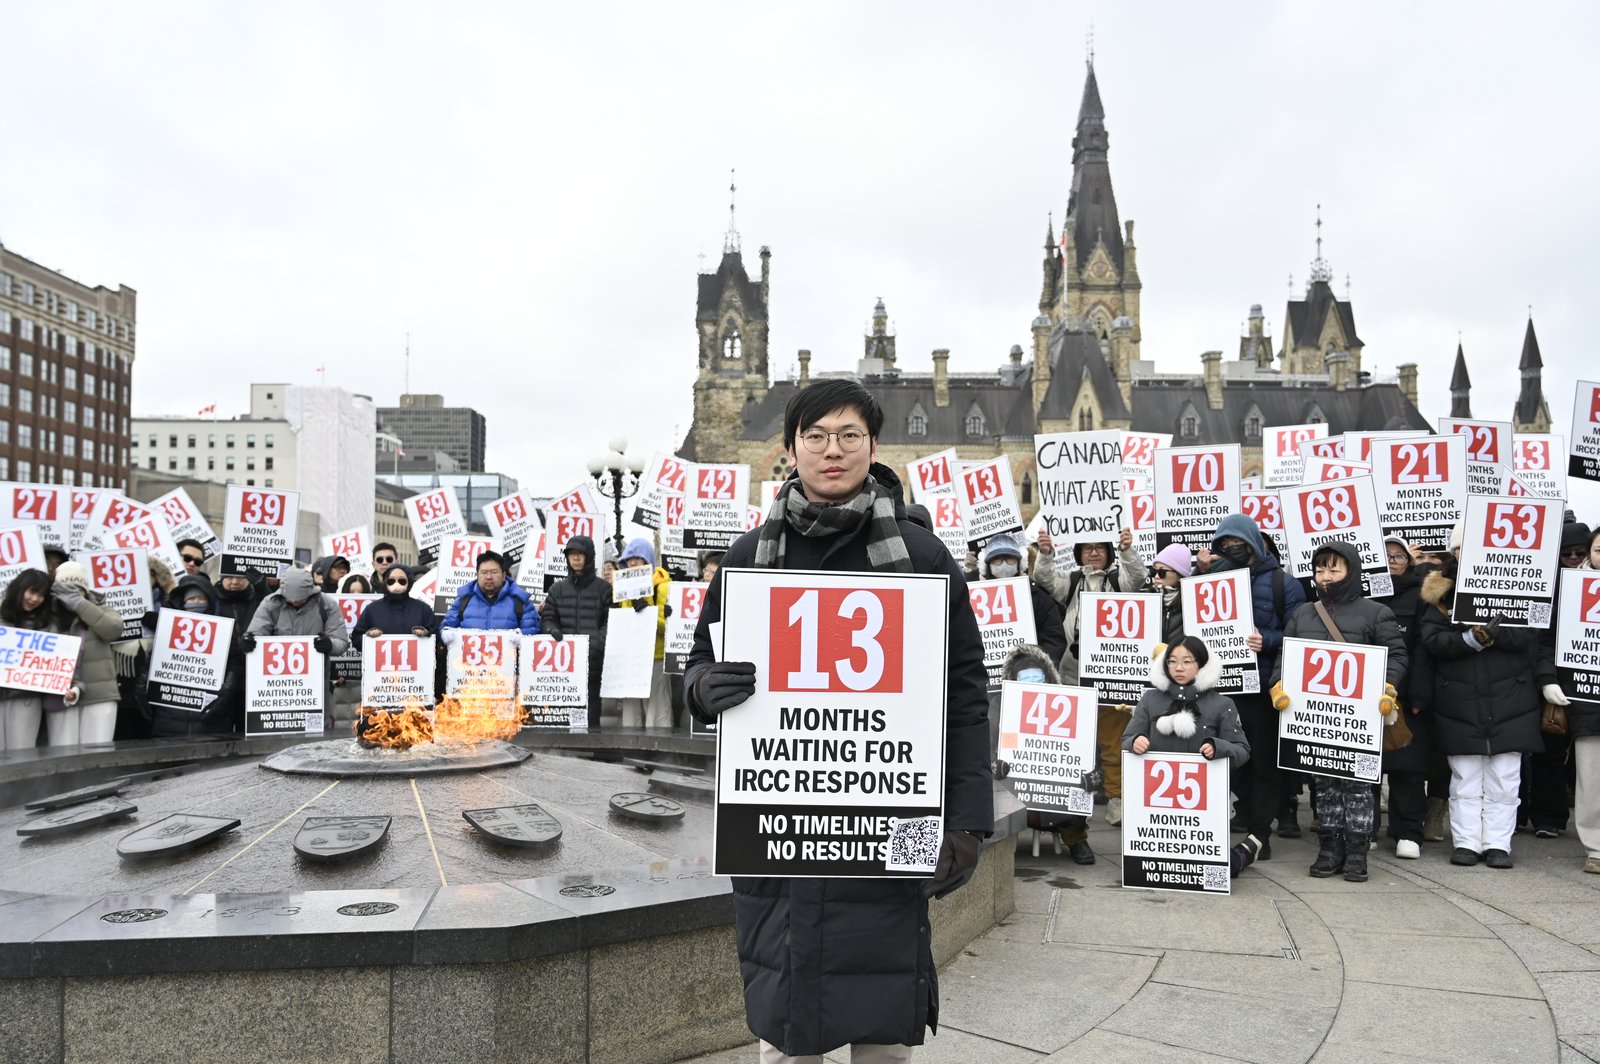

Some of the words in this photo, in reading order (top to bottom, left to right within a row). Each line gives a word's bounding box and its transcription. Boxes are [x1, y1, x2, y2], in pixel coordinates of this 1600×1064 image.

[1282, 430, 1310, 456] 19
[1459, 426, 1494, 462] 22
[1576, 444, 1596, 454] IRCC
[1037, 441, 1122, 469] CANADA
[1124, 438, 1155, 465] 23
[1514, 441, 1546, 470] 43
[1398, 443, 1440, 483] 21
[921, 458, 947, 489] 27
[1178, 454, 1217, 492] 70
[702, 470, 730, 499] 42
[968, 467, 998, 503] 13
[1040, 480, 1086, 506] WHAT
[1088, 480, 1120, 503] ARE
[1178, 496, 1218, 506] MONTHS
[1397, 488, 1442, 499] MONTHS
[17, 488, 53, 520] 27
[246, 493, 280, 525] 39
[419, 493, 446, 521] 39
[497, 498, 523, 525] 19
[975, 501, 1002, 516] MONTHS
[1167, 507, 1208, 517] WAITING
[1210, 506, 1229, 515] FOR
[1305, 487, 1353, 531] 68
[1386, 500, 1430, 510] WAITING
[1433, 499, 1454, 508] FOR
[970, 512, 997, 526] WAITING
[998, 508, 1011, 518] FOR
[1042, 514, 1070, 536] YOU
[1073, 504, 1123, 534] DOING?
[1243, 496, 1281, 530] 23
[1380, 512, 1403, 522] IRCC
[1405, 510, 1460, 521] RESPONSE
[422, 526, 445, 538] WAITING
[446, 522, 457, 530] FOR
[426, 518, 449, 530] MONTHS
[505, 520, 527, 533] MONTHS
[968, 526, 983, 537] IRCC
[983, 516, 1017, 532] RESPONSE
[1162, 519, 1183, 528] IRCC
[1490, 504, 1537, 548] 53
[120, 523, 156, 552] 39
[234, 535, 268, 545] WAITING
[243, 527, 278, 537] MONTHS
[1311, 532, 1357, 547] MONTHS
[227, 544, 246, 552] IRCC
[247, 546, 289, 556] RESPONSE
[336, 534, 358, 558] 25
[1486, 554, 1533, 566] MONTHS
[96, 554, 131, 587] 39
[1473, 566, 1519, 578] WAITING
[1521, 569, 1543, 579] FOR
[1465, 578, 1489, 589] IRCC
[1490, 580, 1547, 592] RESPONSE
[970, 586, 1012, 624] 34
[1199, 579, 1232, 622] 30
[1474, 598, 1487, 606] NO
[1103, 600, 1138, 638] 30
[1476, 608, 1489, 617] NO
[175, 618, 211, 653] 39
[785, 589, 885, 691] 13
[1202, 626, 1234, 638] MONTHS
[16, 631, 58, 652] THE
[1101, 643, 1138, 653] MONTHS
[1228, 637, 1244, 647] FOR
[269, 642, 302, 674] 36
[380, 640, 413, 671] 11
[467, 636, 497, 665] 35
[538, 642, 568, 672] 20
[1564, 652, 1588, 664] IRCC
[172, 654, 207, 666] MONTHS
[1091, 654, 1128, 664] WAITING
[1131, 656, 1148, 665] FOR
[161, 661, 196, 673] WAITING
[198, 667, 214, 676] FOR
[1085, 665, 1105, 674] IRCC
[1309, 649, 1357, 697] 20
[154, 670, 173, 680] IRCC
[174, 673, 217, 686] RESPONSE
[1574, 672, 1587, 682] NO
[258, 689, 294, 697] WAITING
[1106, 682, 1144, 691] TIMELINES
[1576, 684, 1590, 694] NO
[273, 699, 317, 707] RESPONSE
[1109, 692, 1141, 700] RESULTS
[1028, 692, 1070, 737] 42
[1307, 699, 1355, 715] MONTHS
[780, 708, 886, 732] MONTHS
[1294, 711, 1341, 727] WAITING
[1345, 718, 1367, 731] FOR
[1287, 723, 1311, 736] IRCC
[1313, 727, 1373, 745] RESPONSE
[751, 738, 857, 762] WAITING
[865, 740, 913, 764] FOR
[1025, 740, 1069, 753] MONTHS
[1297, 744, 1310, 754] NO
[1012, 750, 1057, 764] WAITING
[1060, 755, 1080, 766] FOR
[1300, 755, 1313, 765] NO
[1315, 758, 1355, 772] RESULTS
[734, 768, 790, 792] IRCC
[794, 770, 927, 794] RESPONSE
[1015, 782, 1027, 790] NO
[1152, 761, 1199, 809] 25
[1018, 792, 1030, 801] NO
[759, 815, 788, 834] NO
[1150, 814, 1200, 827] MONTHS
[1138, 826, 1187, 840] WAITING
[1191, 830, 1214, 842] FOR
[768, 840, 796, 860] NO
[802, 841, 887, 861] RESULTS
[1130, 840, 1156, 852] IRCC
[1158, 842, 1221, 856] RESPONSE
[1142, 861, 1156, 870] NO
[1147, 873, 1160, 882] NO
[1163, 874, 1204, 886] RESULTS
